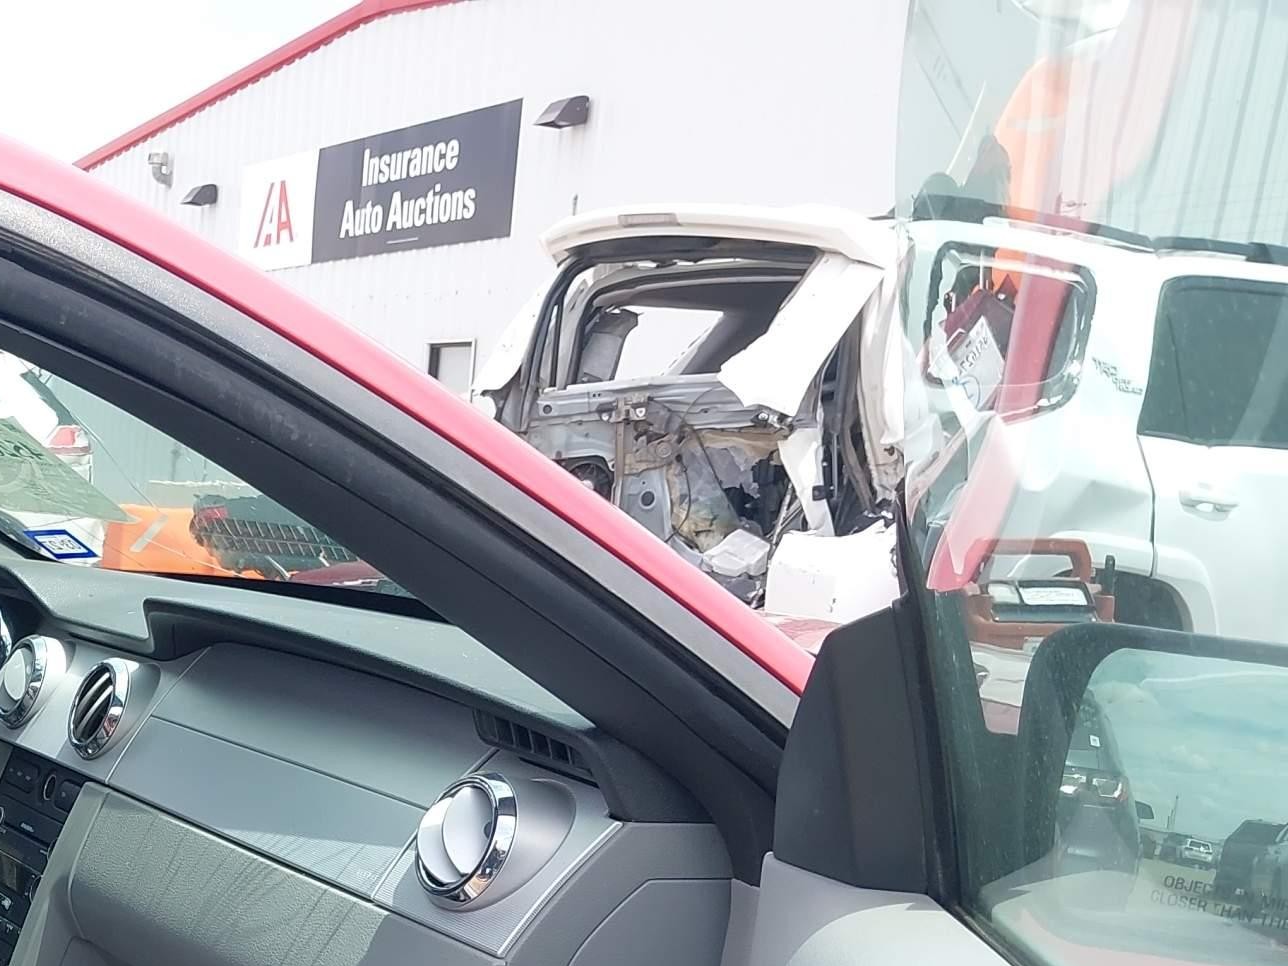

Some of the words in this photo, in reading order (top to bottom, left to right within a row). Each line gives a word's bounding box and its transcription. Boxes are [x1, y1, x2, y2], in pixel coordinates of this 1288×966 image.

[362, 138, 460, 187] Insurance
[339, 199, 384, 240] Auto
[386, 182, 477, 232] Auctions
